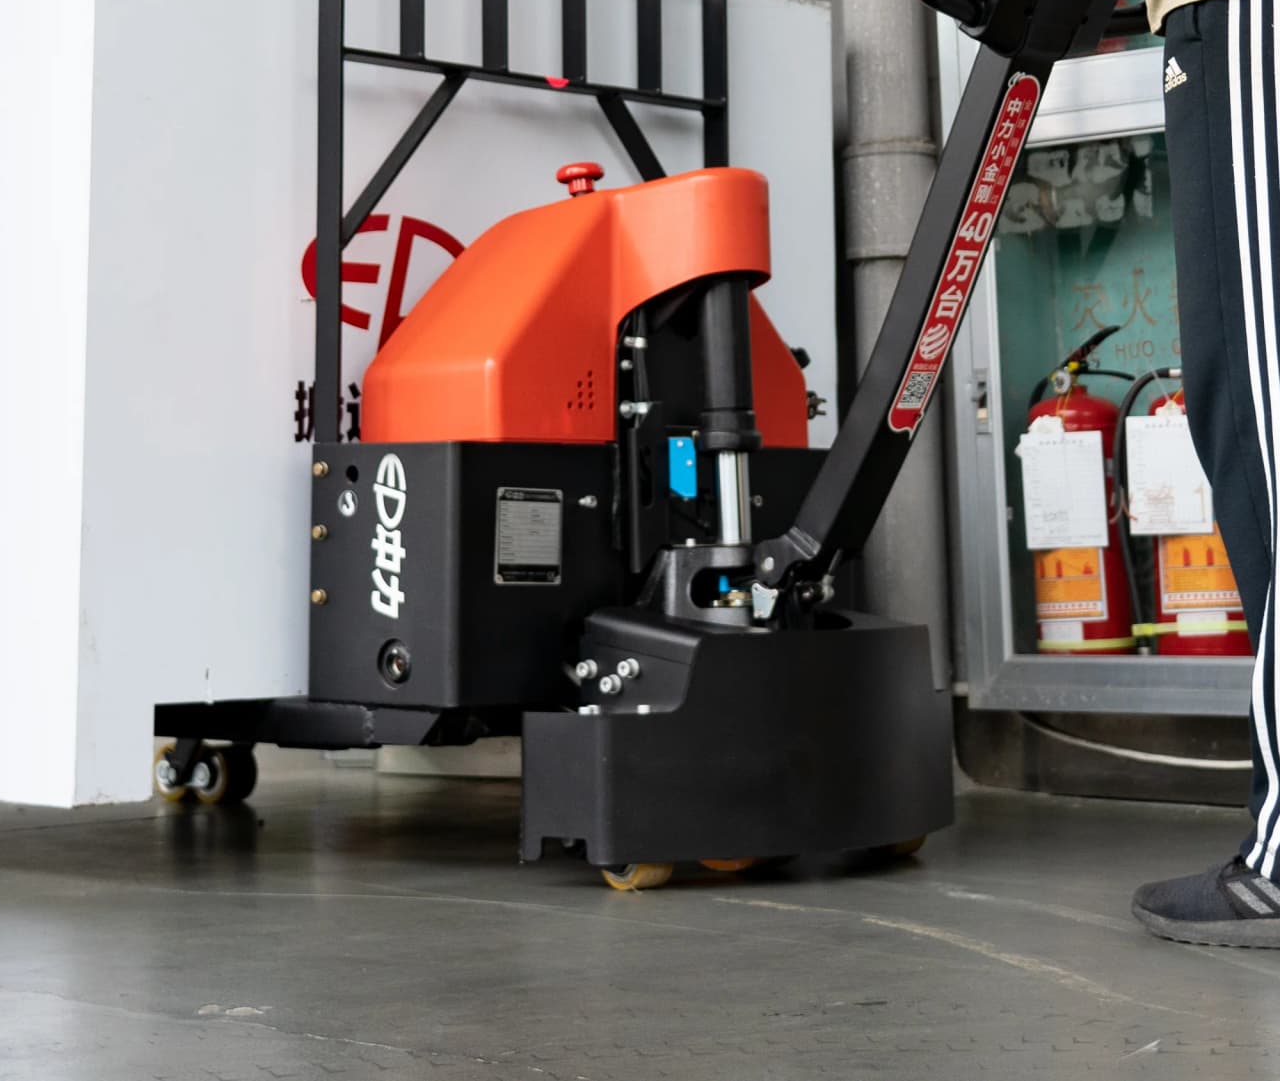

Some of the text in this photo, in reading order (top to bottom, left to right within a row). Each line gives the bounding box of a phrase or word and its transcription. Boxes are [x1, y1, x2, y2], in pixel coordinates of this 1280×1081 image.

[974, 97, 1024, 204] 中力小金刚
[1071, 267, 1179, 331] 灭火
